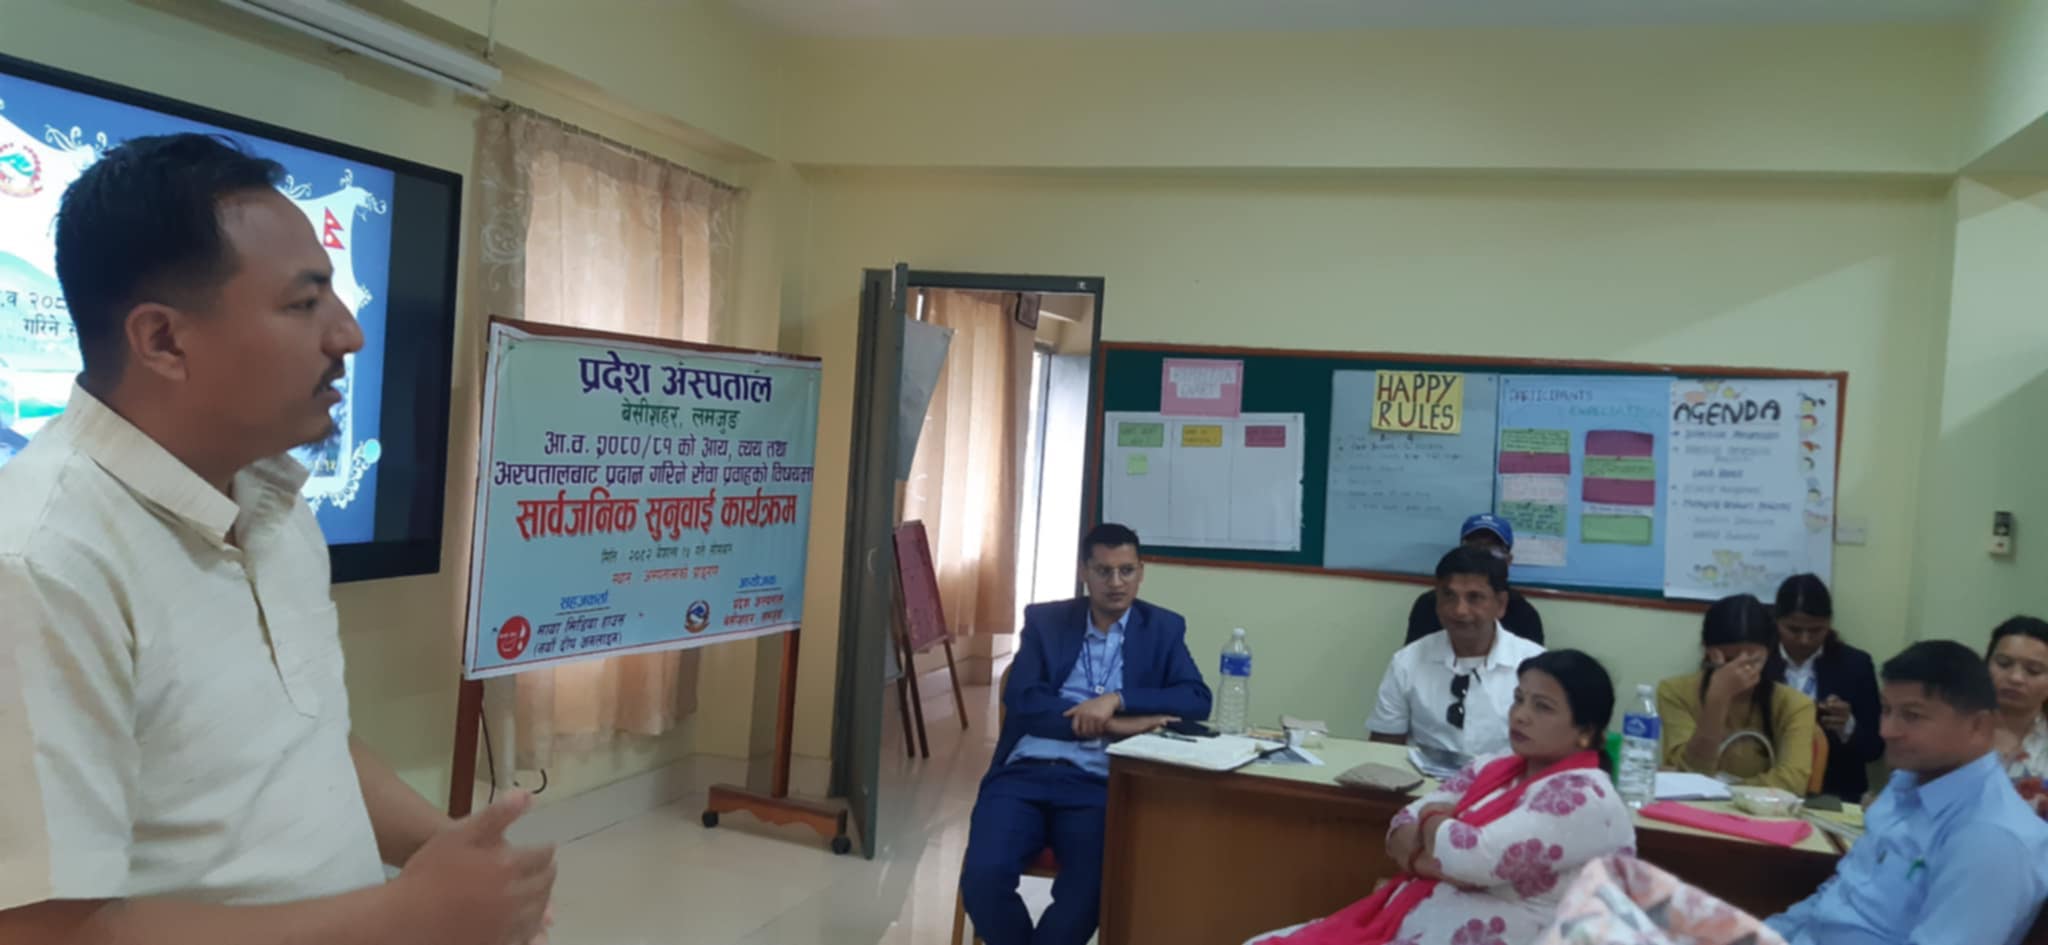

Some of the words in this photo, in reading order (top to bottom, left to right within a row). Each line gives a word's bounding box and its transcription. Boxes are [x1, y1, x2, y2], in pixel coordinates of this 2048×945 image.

[22, 313, 61, 336] गरिने
[579, 350, 651, 395] प्रदेश
[1377, 373, 1457, 404] HAPPY
[1377, 402, 1455, 431] RULES
[1673, 399, 1781, 426] AGENDA
[544, 431, 589, 455] आ.व.
[596, 434, 672, 460] २०८०/८१
[677, 434, 696, 455] को
[494, 461, 601, 486] अस्पतालबाट
[605, 464, 645, 487] प्रदान
[649, 460, 688, 484] गरिने
[691, 460, 718, 484] सेवा
[723, 461, 768, 485] प्रवाहको
[515, 486, 640, 541] सार्वजनिक
[645, 487, 716, 541] सुनुवाई
[721, 487, 798, 528] कार्यक्रम
